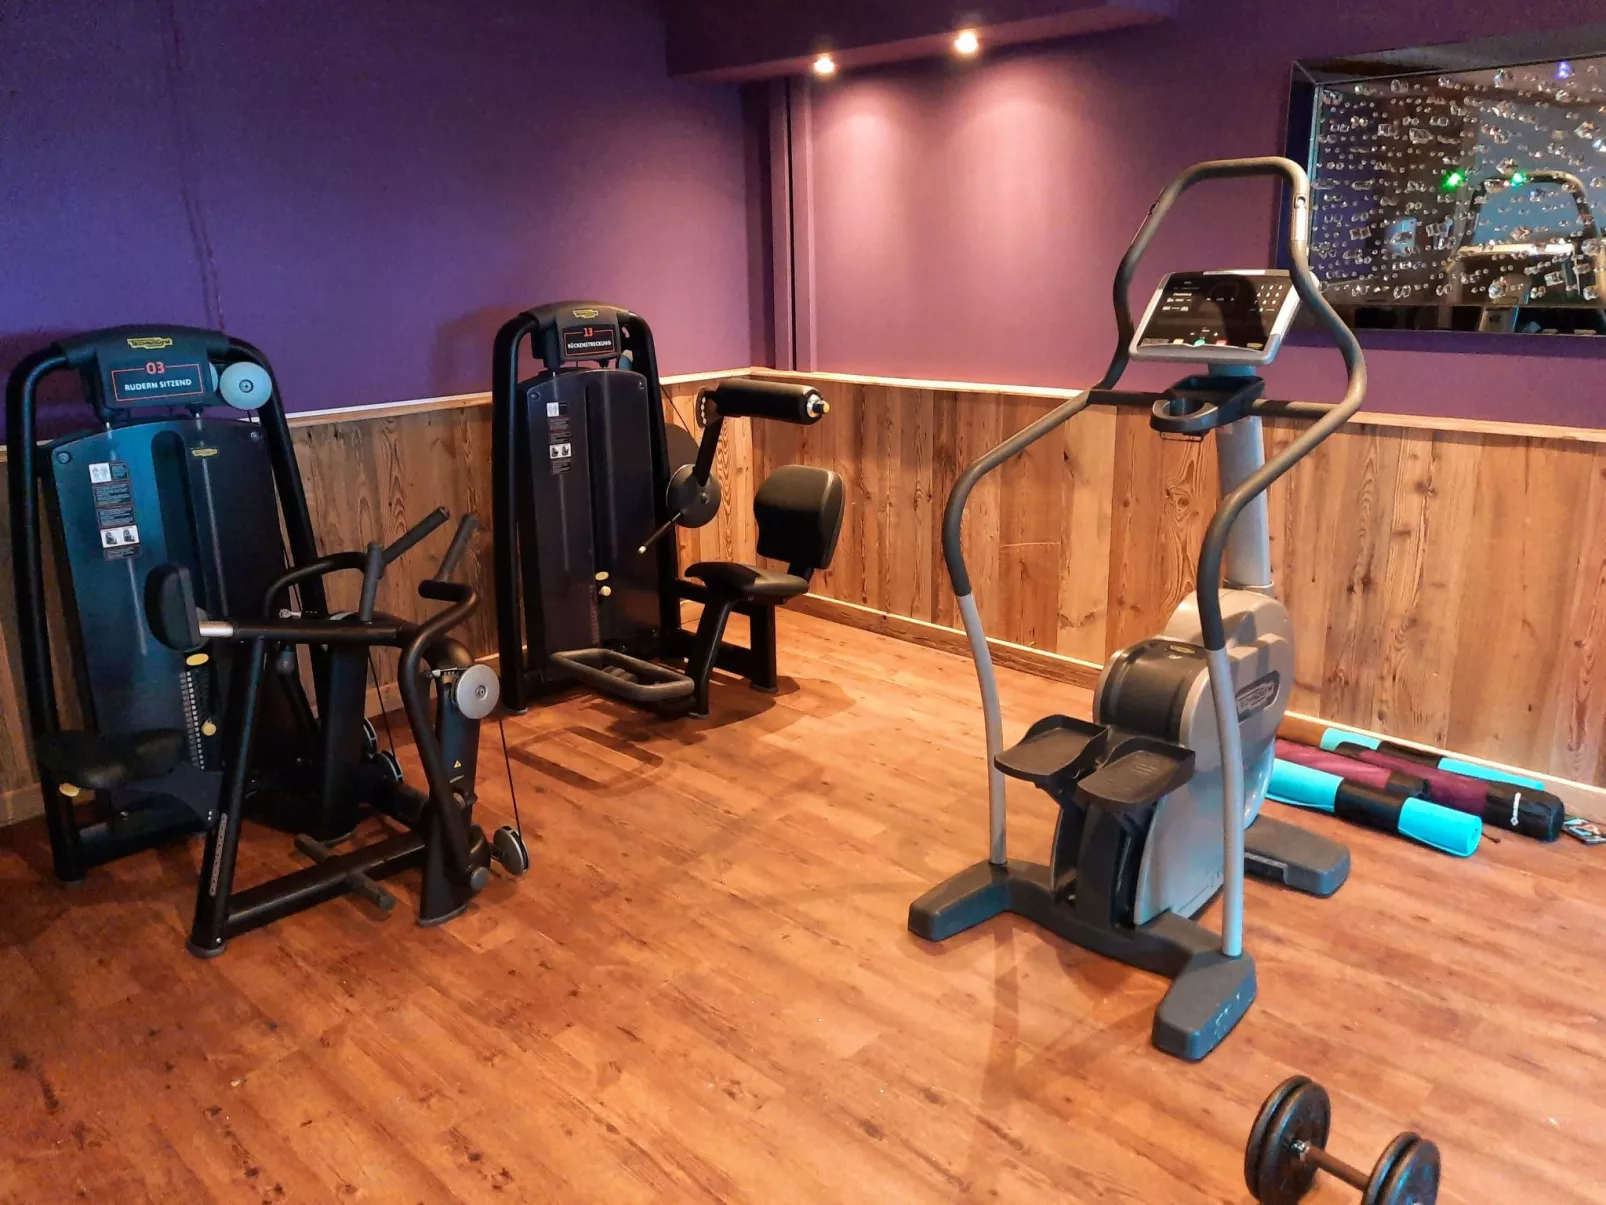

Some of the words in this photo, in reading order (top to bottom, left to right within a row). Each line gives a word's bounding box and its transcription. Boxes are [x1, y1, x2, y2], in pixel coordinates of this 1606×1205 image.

[583, 327, 593, 337] 13
[146, 361, 165, 374] 03
[124, 381, 158, 391] RUDERN
[160, 379, 192, 388] SITZEND
